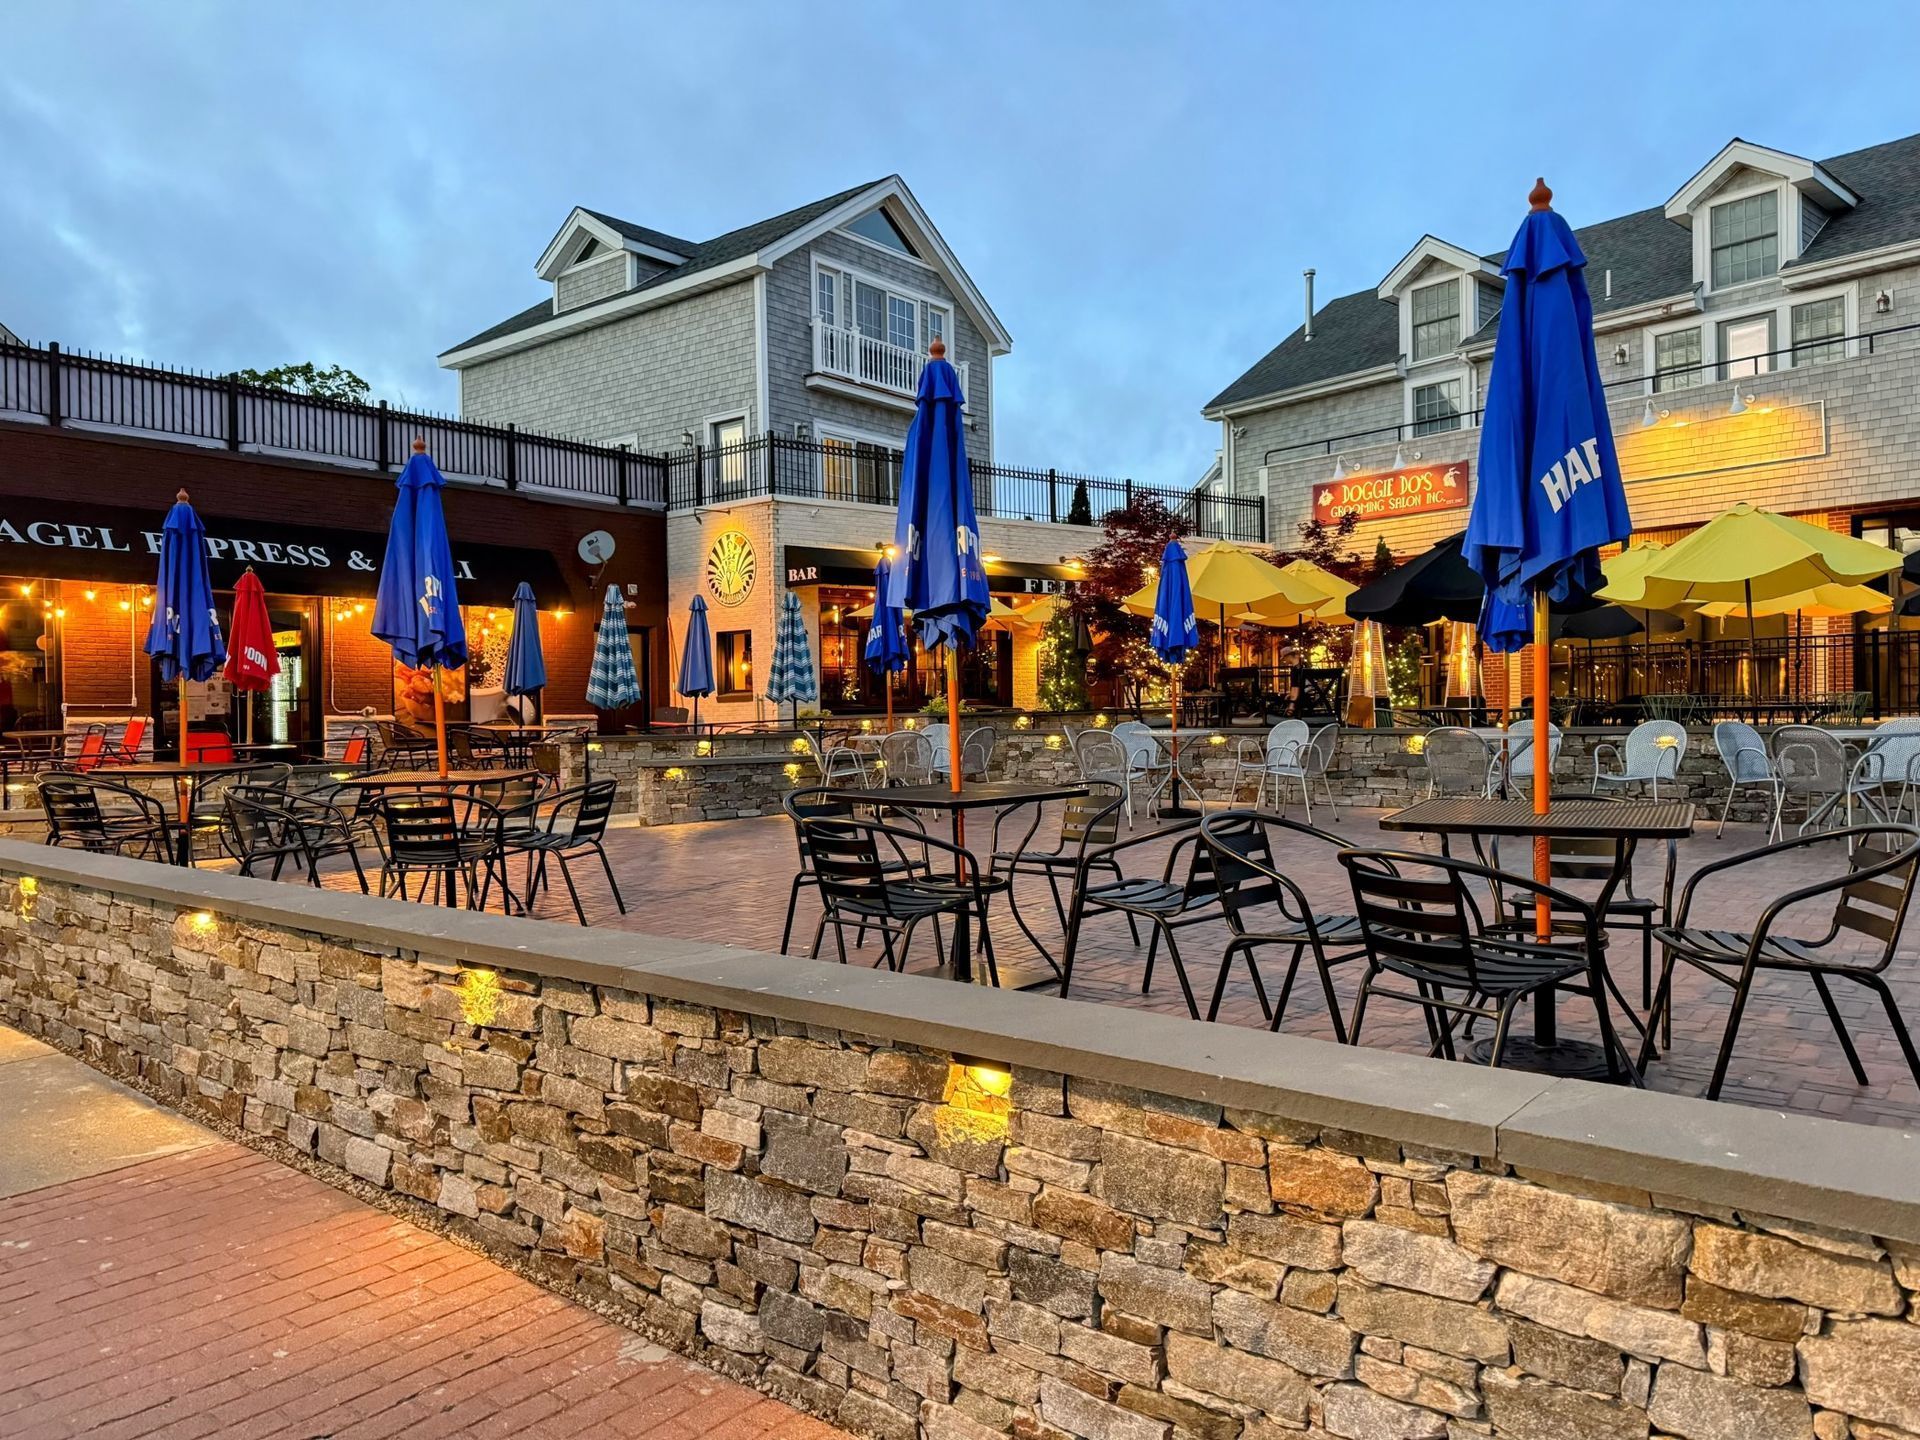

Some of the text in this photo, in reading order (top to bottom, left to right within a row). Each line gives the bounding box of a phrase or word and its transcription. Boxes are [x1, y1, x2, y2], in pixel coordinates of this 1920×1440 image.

[1342, 471, 1433, 504] DOGGIE DO'S
[1330, 499, 1385, 518] GROOMING
[1388, 495, 1422, 510] SALON
[1426, 490, 1446, 504] INC.
[139, 531, 331, 568] EPRESS
[347, 550, 377, 572] &
[788, 566, 818, 582] BAR
